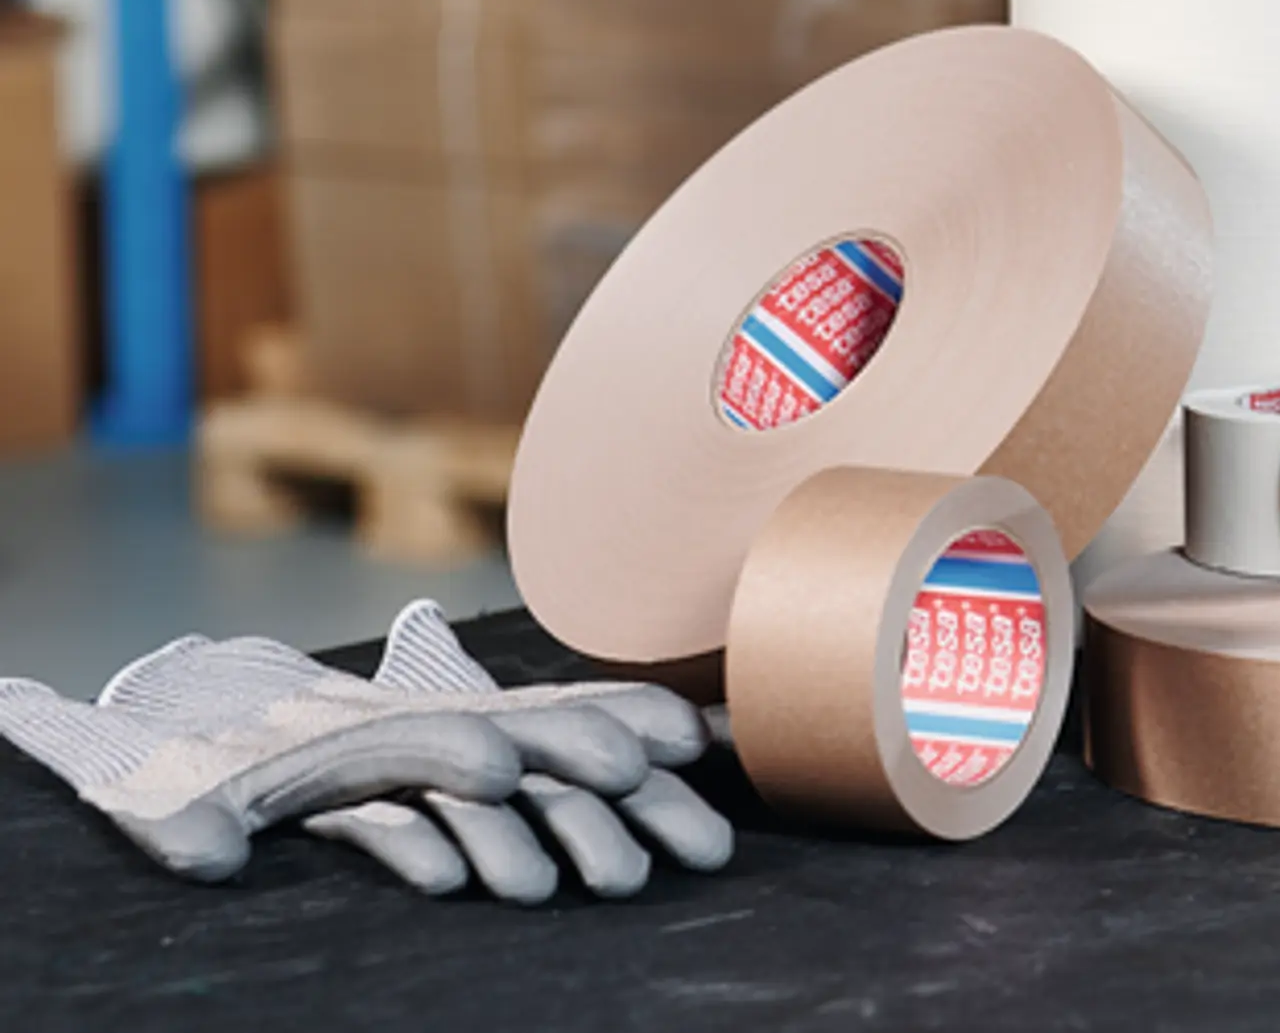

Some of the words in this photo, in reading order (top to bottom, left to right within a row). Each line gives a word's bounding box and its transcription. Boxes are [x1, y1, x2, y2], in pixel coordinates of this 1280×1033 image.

[928, 609, 958, 694] tesa
[956, 611, 986, 696] tesa
[984, 614, 1013, 698] tesa
[1010, 618, 1041, 703] tesa
